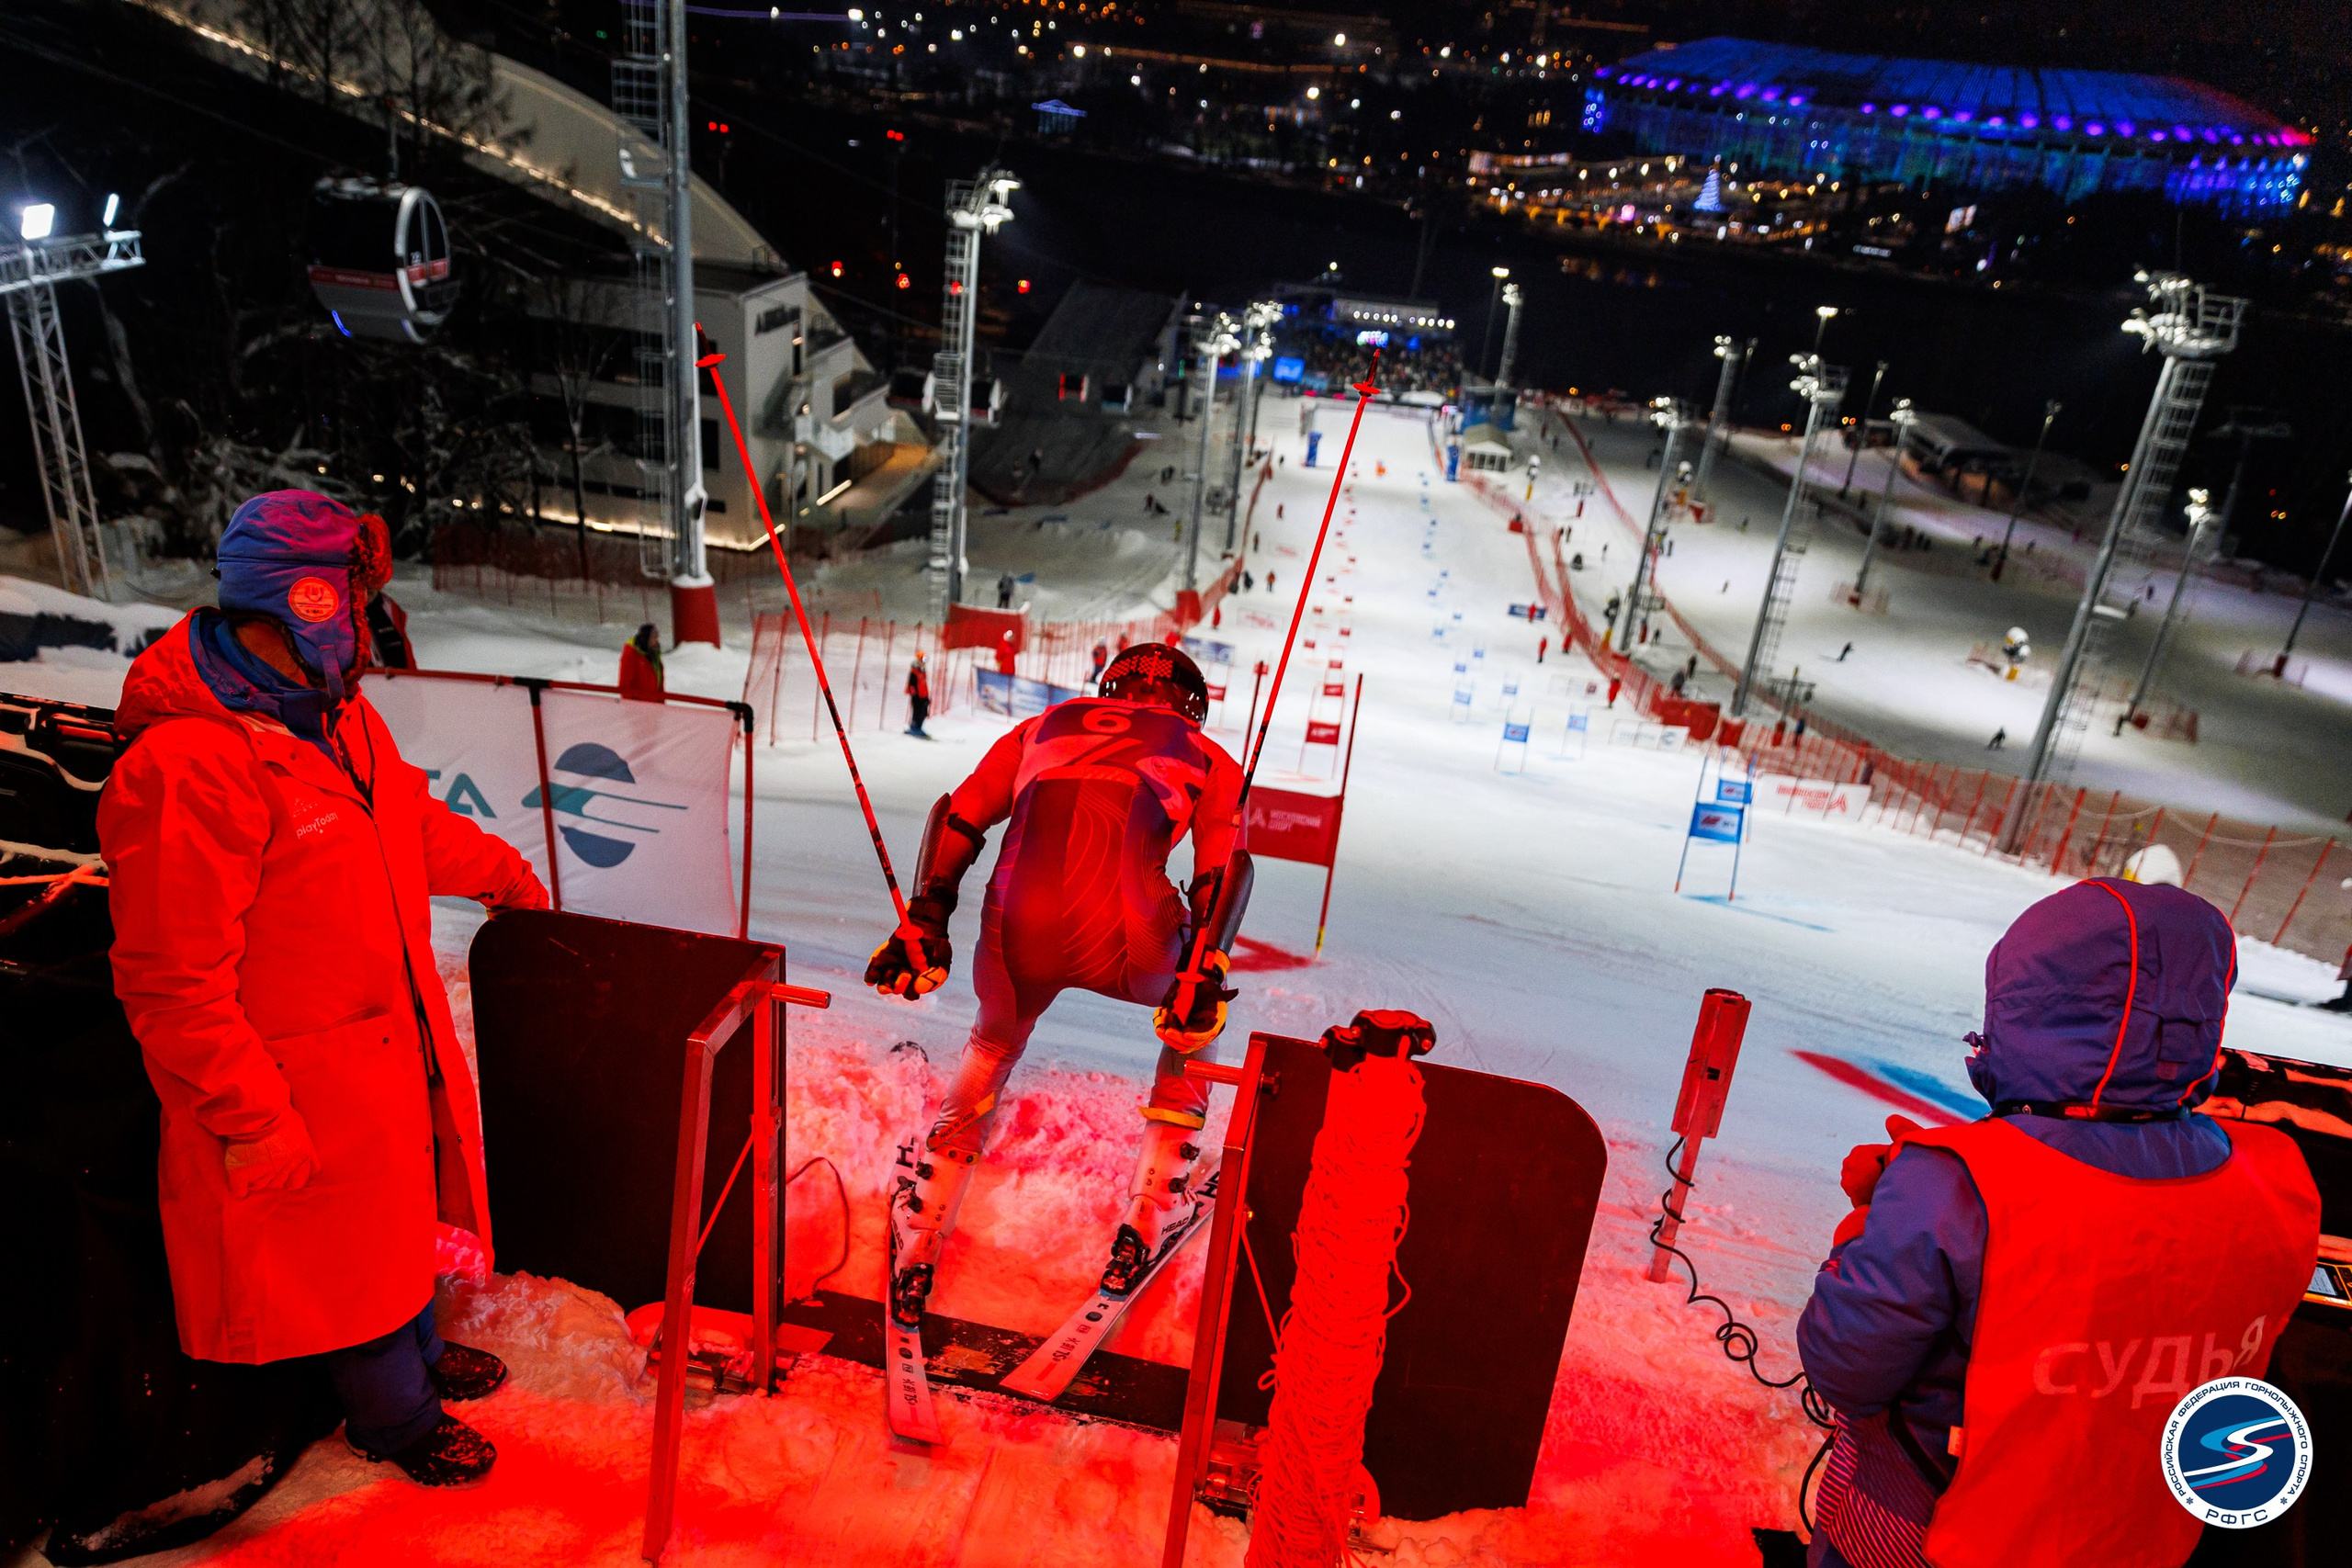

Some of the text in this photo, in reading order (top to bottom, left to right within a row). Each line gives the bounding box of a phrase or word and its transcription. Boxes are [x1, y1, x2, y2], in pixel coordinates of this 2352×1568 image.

[1082, 706, 1132, 734] 6
[296, 812, 339, 840] playToday
[1161, 1216, 1190, 1235] HEAD
